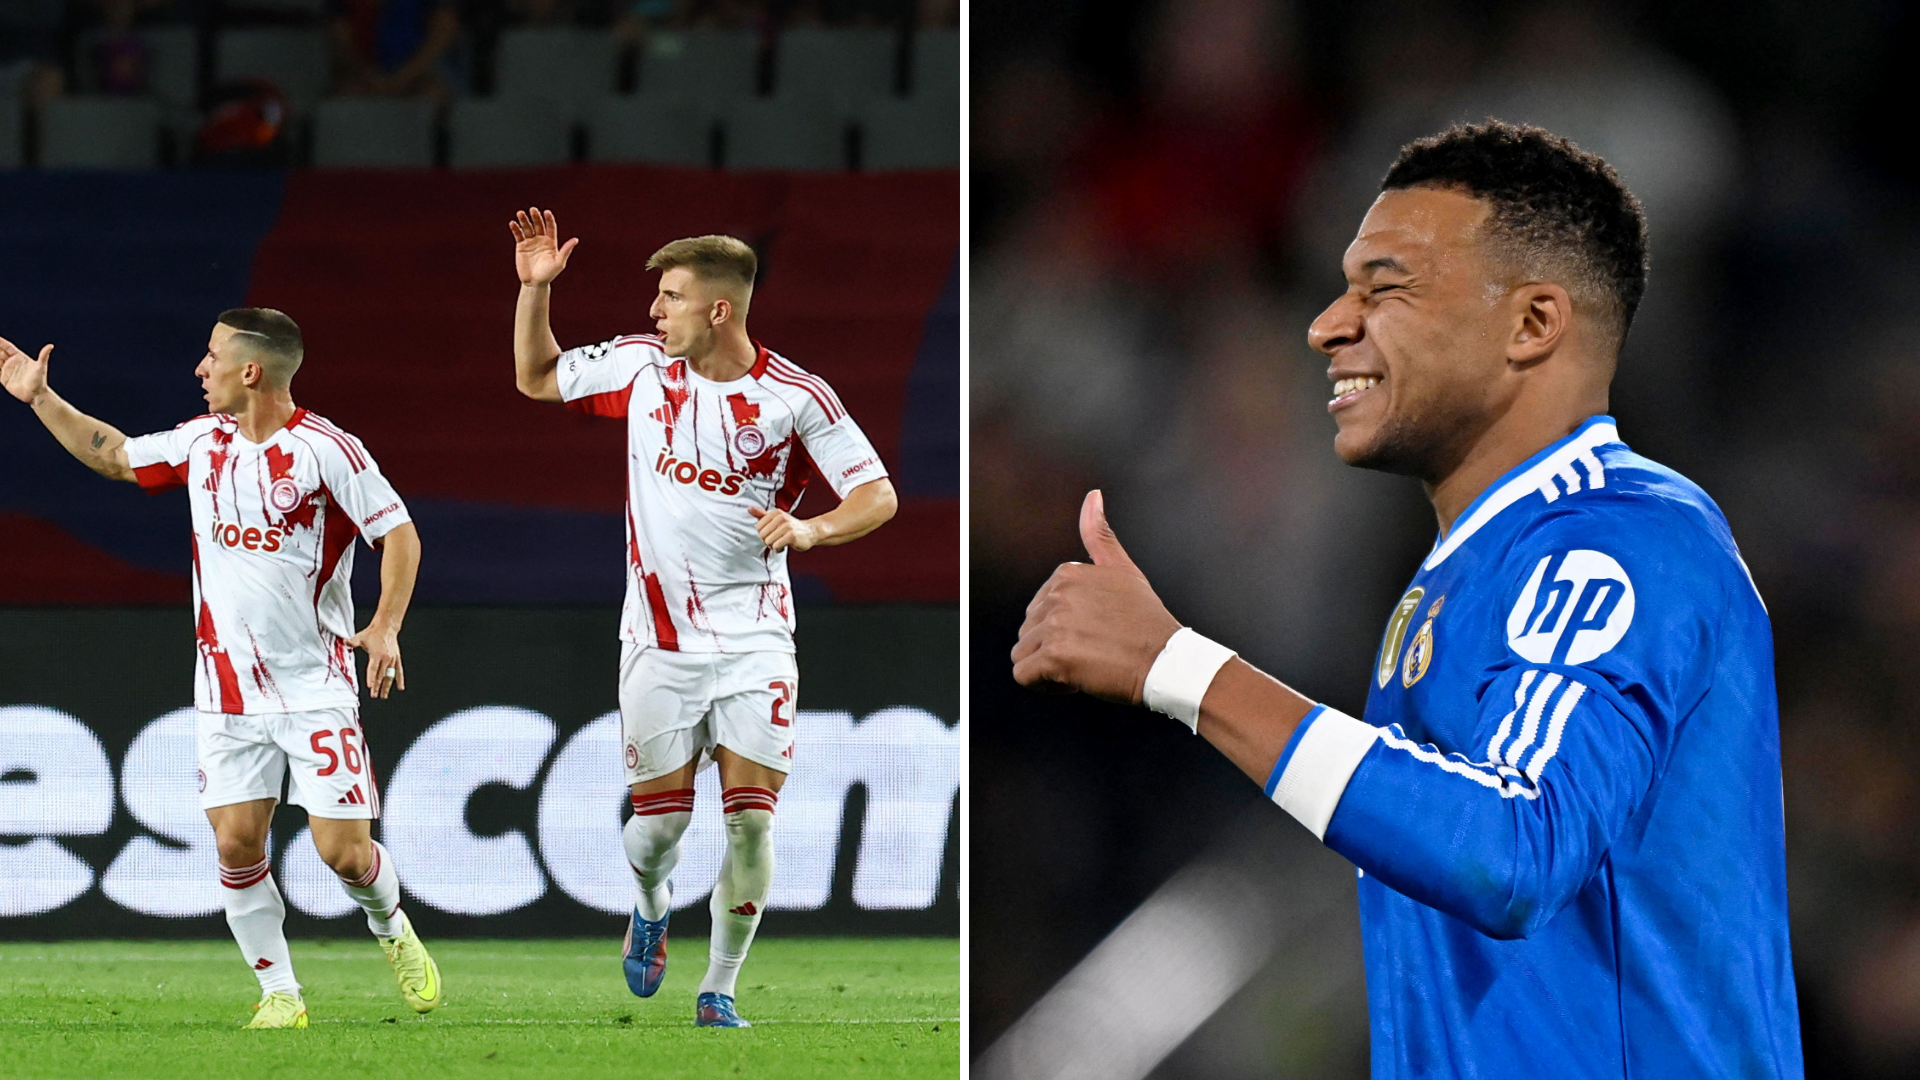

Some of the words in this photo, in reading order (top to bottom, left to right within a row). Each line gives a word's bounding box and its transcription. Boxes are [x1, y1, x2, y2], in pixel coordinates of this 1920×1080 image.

[655, 447, 744, 496] iroes
[212, 514, 282, 552] iroes
[363, 502, 400, 526] SHOPFLIX
[1511, 549, 1630, 666] hp
[310, 727, 361, 776] 56
